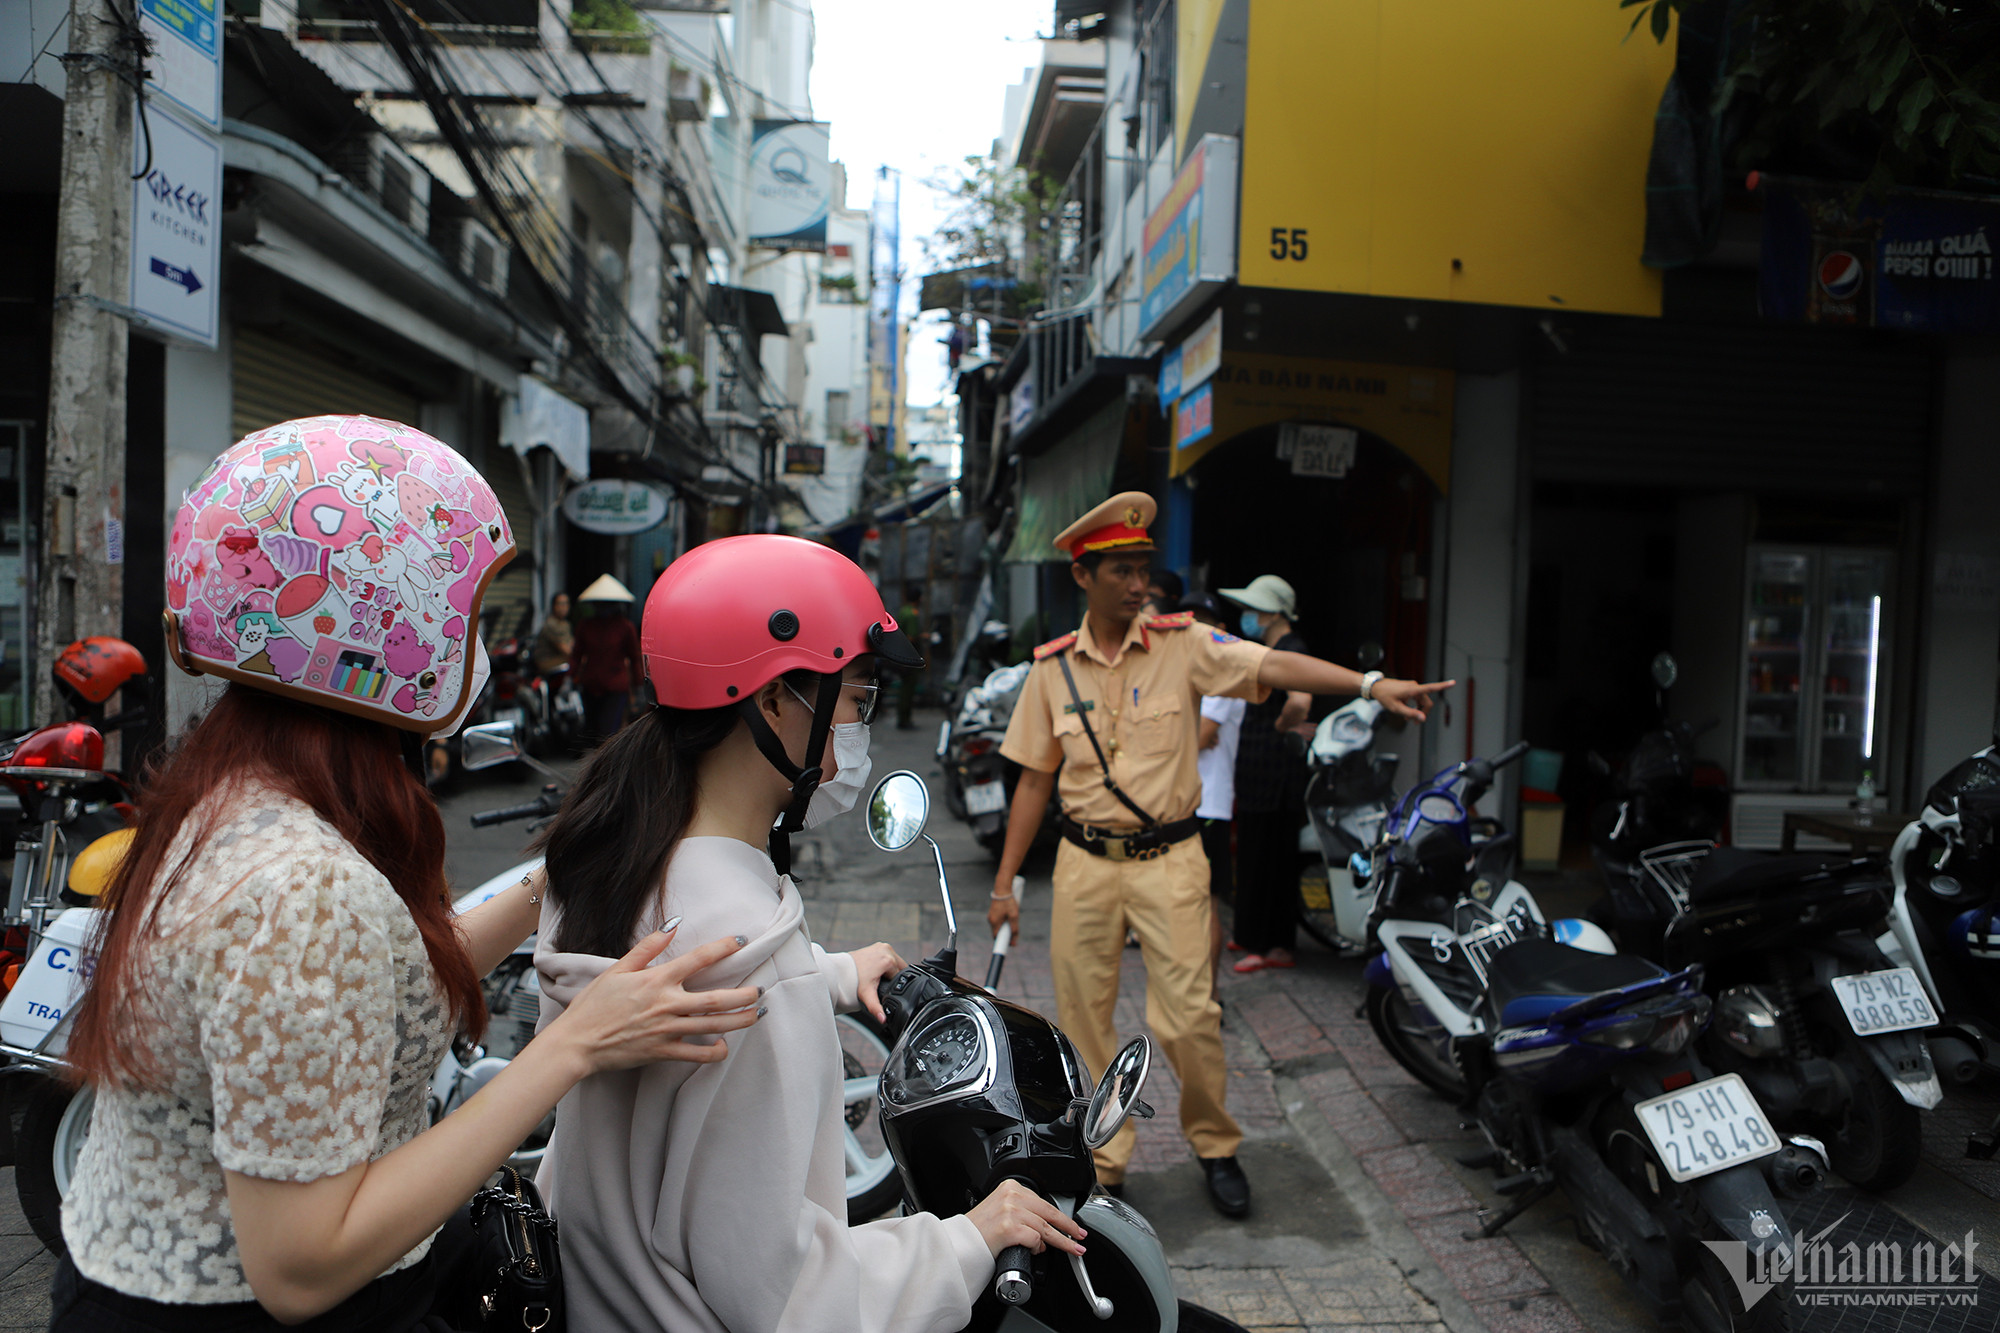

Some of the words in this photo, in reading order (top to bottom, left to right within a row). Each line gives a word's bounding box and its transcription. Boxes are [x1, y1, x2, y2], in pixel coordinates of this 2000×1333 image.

[146, 168, 209, 227] GREEK
[150, 208, 207, 247] KITCHEN
[1939, 225, 1992, 255] QUÁ
[1271, 227, 1308, 262] 55
[1883, 256, 1930, 277] PEPSI
[349, 579, 404, 612] IBES
[350, 601, 395, 630] BAD
[349, 622, 383, 646] NO
[1847, 974, 1911, 1004] 79-N2
[27, 1001, 62, 1021] TRA
[1852, 998, 1931, 1031] 988.59
[1655, 1085, 1738, 1135] 79-H1
[1665, 1116, 1769, 1173] 248.48
